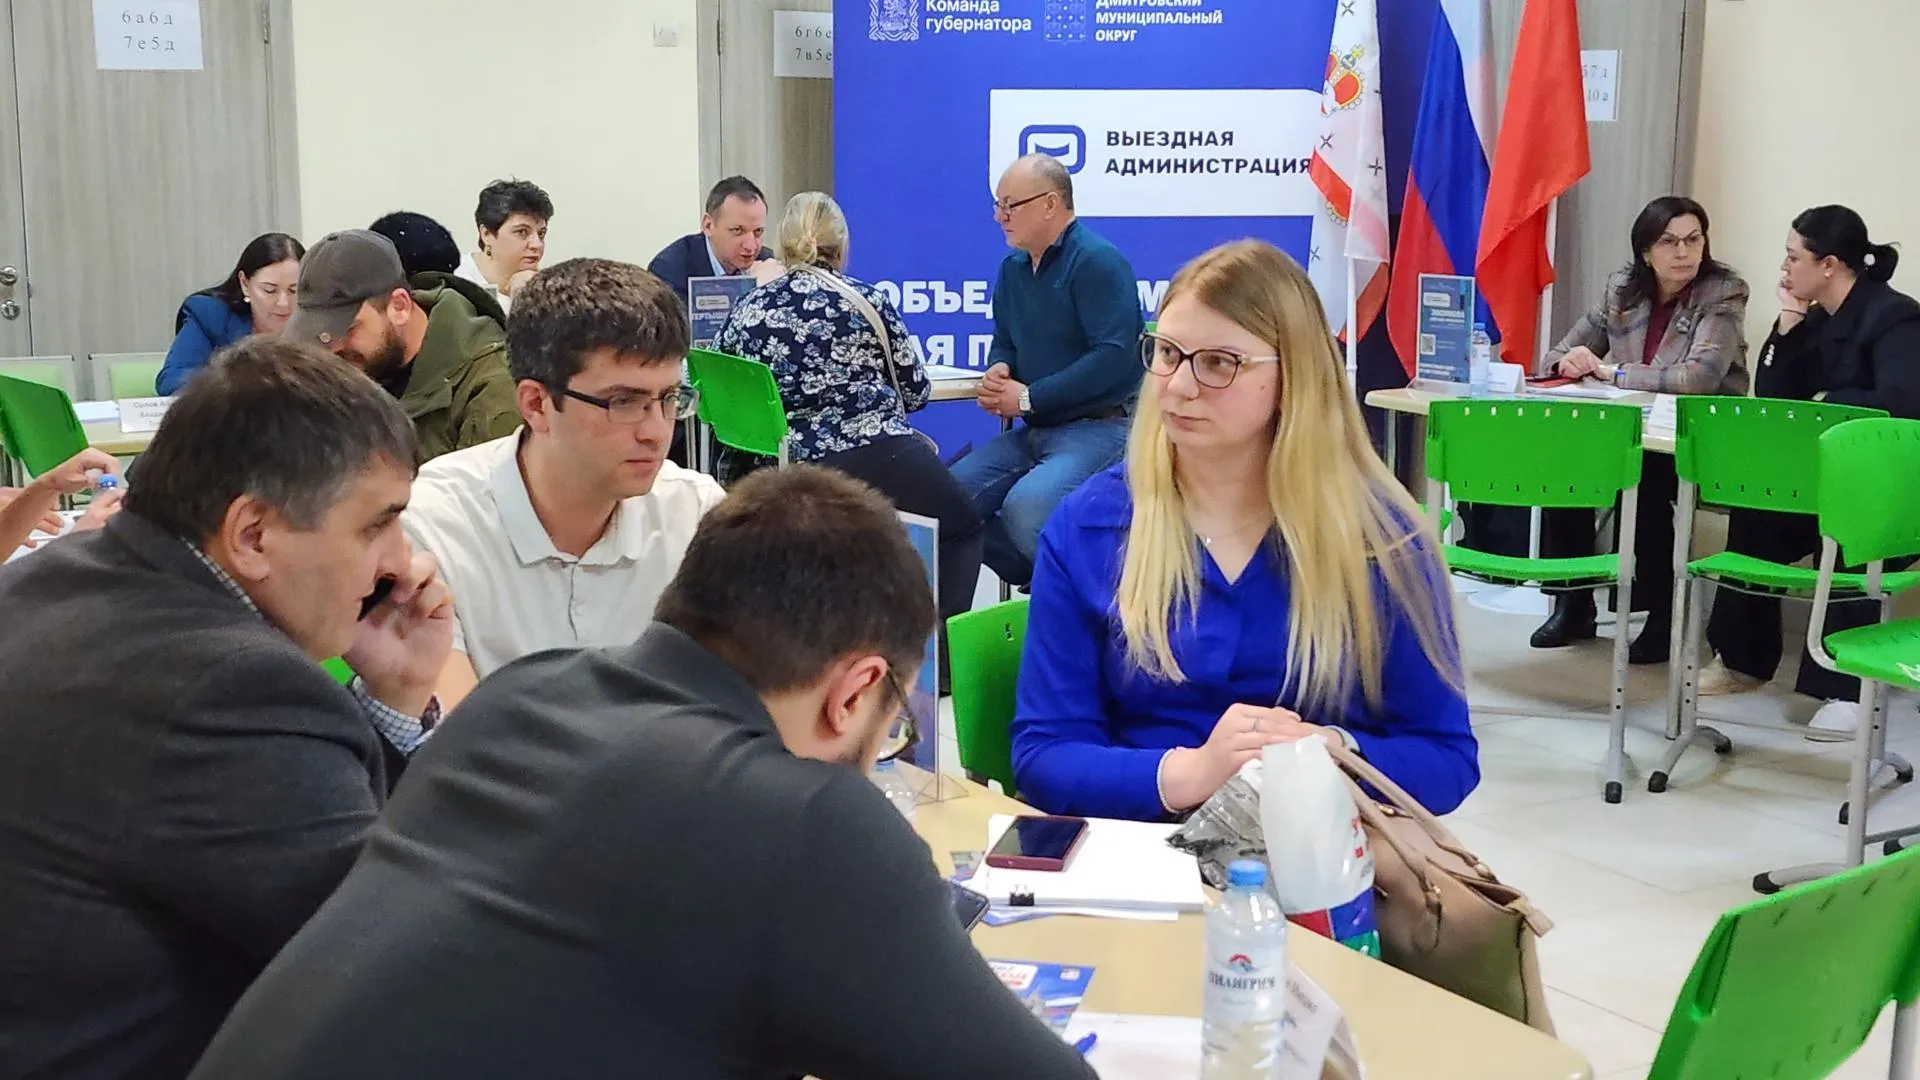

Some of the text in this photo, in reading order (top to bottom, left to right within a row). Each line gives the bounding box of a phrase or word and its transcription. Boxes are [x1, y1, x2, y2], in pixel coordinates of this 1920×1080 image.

[925, 0, 1000, 14] Команда
[925, 15, 1032, 34] губернатора
[1095, 10, 1223, 26] МУНИЦИПАЛЬНЫЙ
[1095, 29, 1138, 42] ОКРУГ
[1106, 130, 1234, 149] ВЫЕЗДНАЯ
[1105, 158, 1312, 176] АДМИНИСТРАЦИЯ
[874, 280, 993, 319] ОБЪЕ
